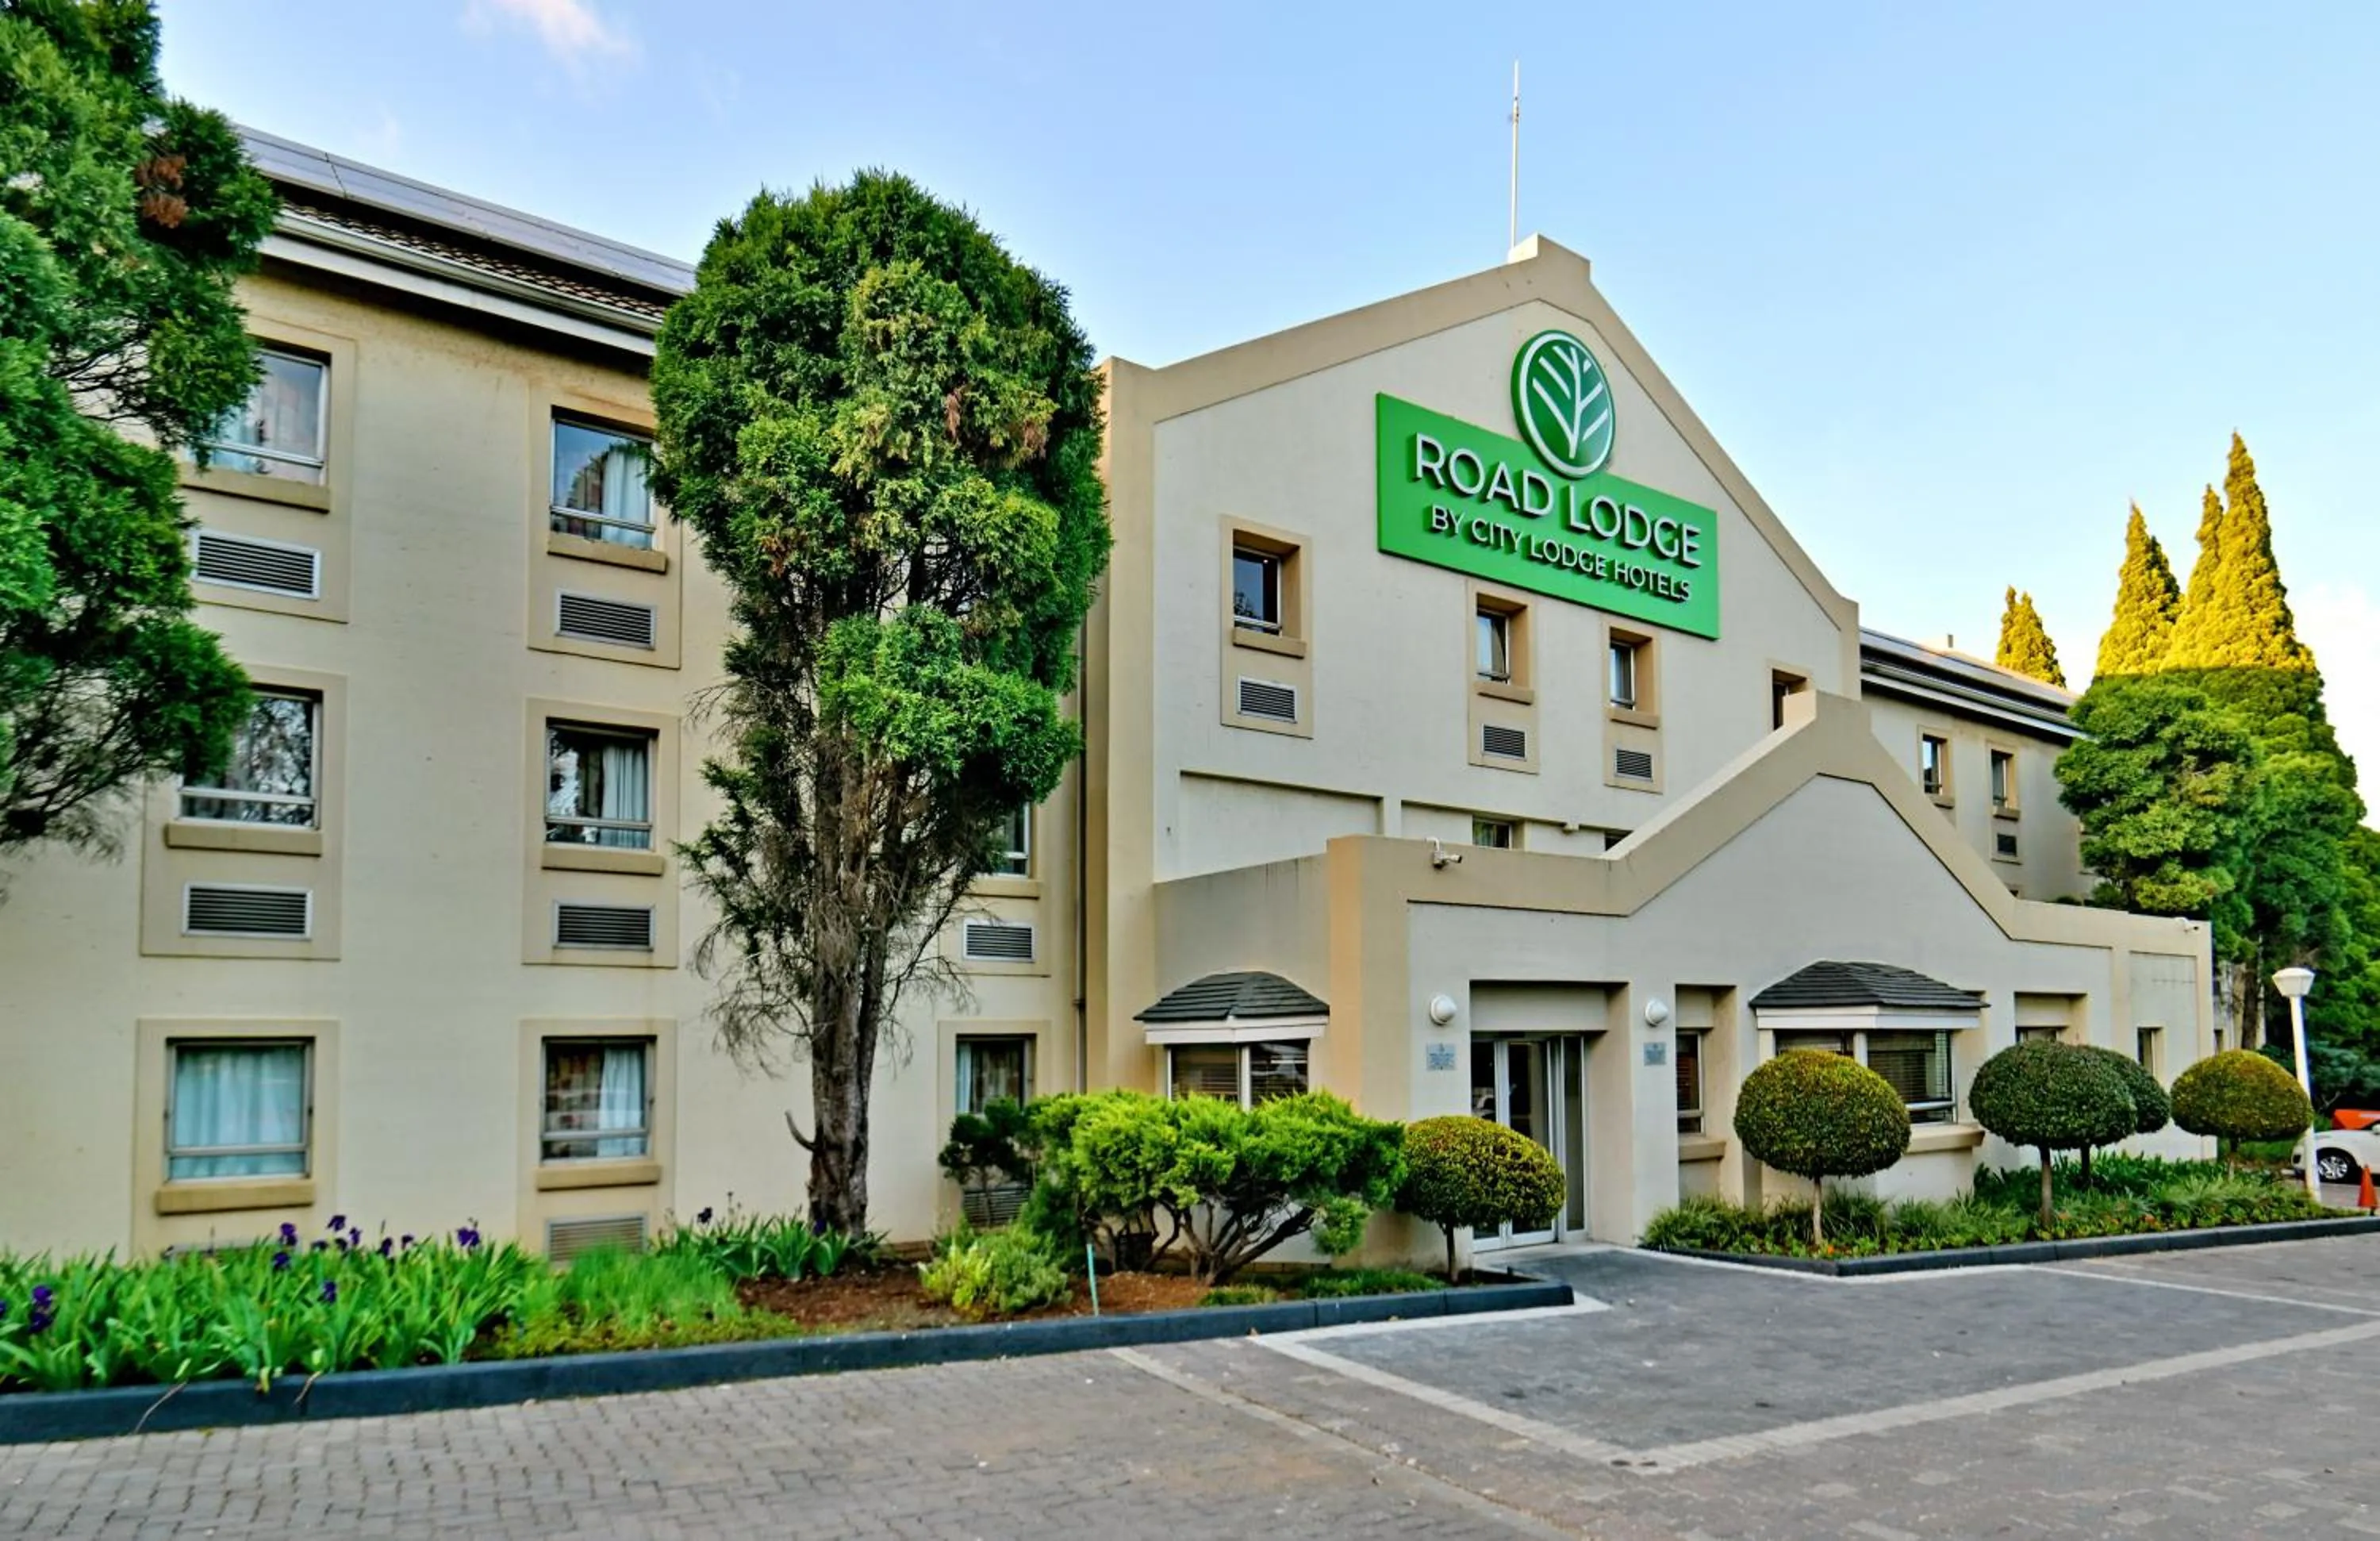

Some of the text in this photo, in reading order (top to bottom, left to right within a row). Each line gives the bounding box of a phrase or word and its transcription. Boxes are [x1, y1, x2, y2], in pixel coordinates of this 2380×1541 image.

[1416, 432, 1702, 567] ROAD LODGE
[1431, 505, 1691, 601] BY CITY LODGE HOTELS
